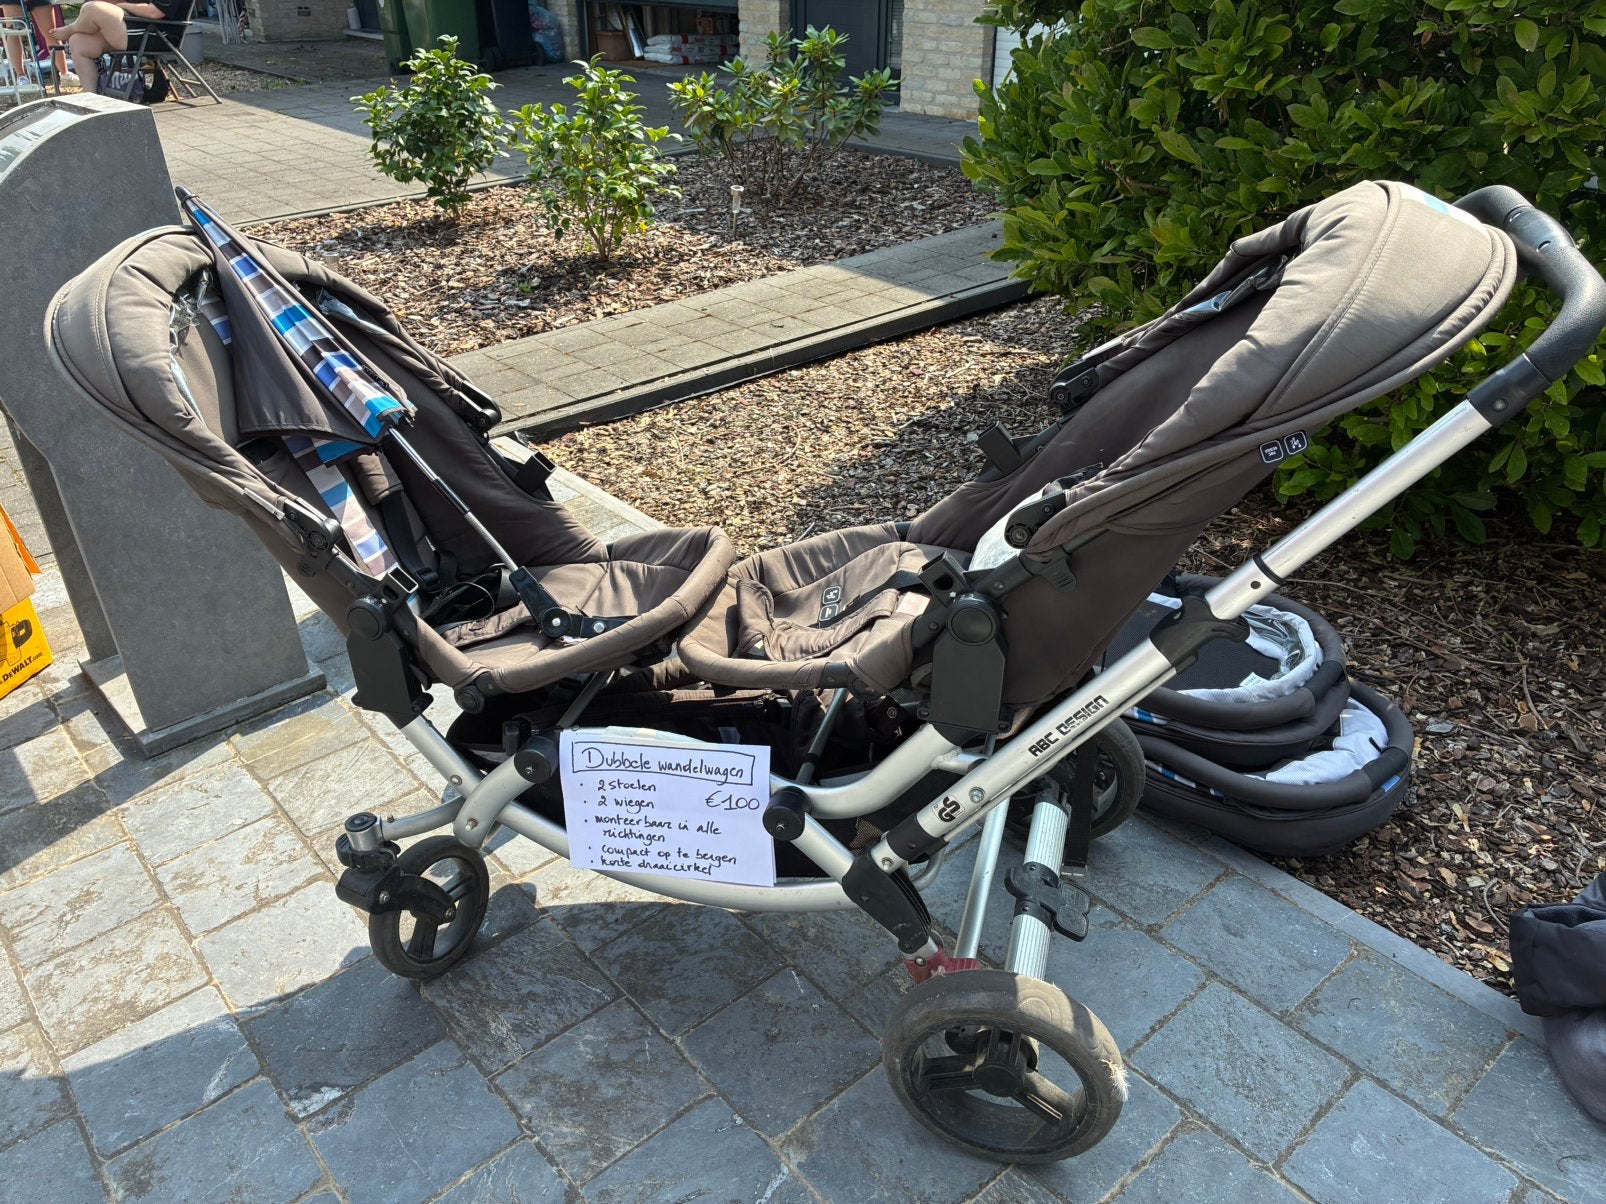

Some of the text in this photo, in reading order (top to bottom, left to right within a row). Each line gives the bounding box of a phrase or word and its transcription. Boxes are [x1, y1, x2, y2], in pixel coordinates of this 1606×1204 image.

[1028, 694, 1110, 757] ABC DESIGN
[582, 747, 744, 786] Dubbele wandelwagen
[597, 778, 656, 791] 2 stoelen
[597, 795, 654, 814] 2 wiegen
[705, 790, 760, 810] €100
[603, 828, 665, 846] richtingen
[678, 820, 689, 831] in
[696, 821, 722, 835] alle
[600, 855, 712, 875] korte draaicirkel
[602, 844, 737, 868] compact op te bergen
